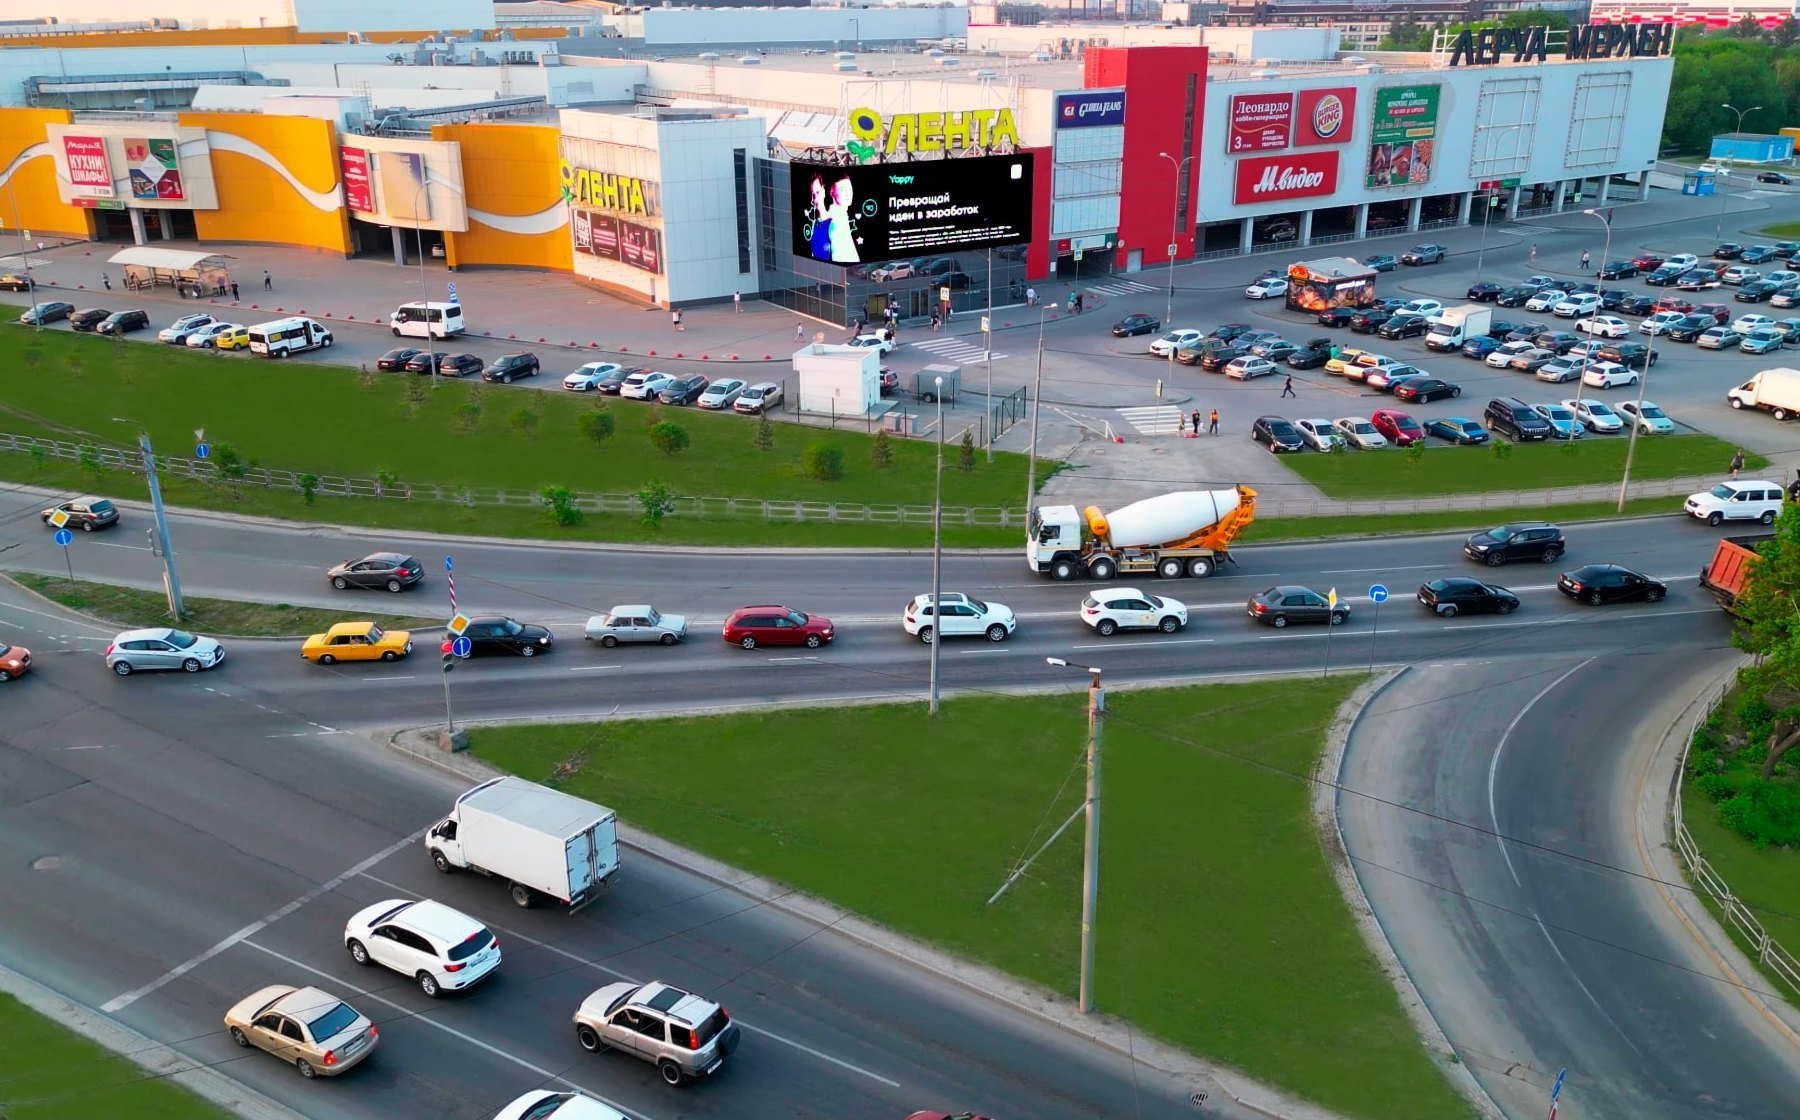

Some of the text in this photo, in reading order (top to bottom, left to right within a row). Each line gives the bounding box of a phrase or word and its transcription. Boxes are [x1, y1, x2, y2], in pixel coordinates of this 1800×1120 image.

[1450, 23, 1673, 66] ЛЕРУА МЕРЛЕН
[1236, 102, 1289, 114] Леонардо
[1318, 103, 1339, 118] BURGER
[1318, 110, 1339, 126] KING
[885, 107, 1019, 154] ЛЕНТА
[67, 141, 102, 153] Мария
[1234, 136, 1242, 149] 3
[69, 154, 106, 171] КУХНИ!
[72, 167, 109, 183] ШКАФЫ!
[889, 175, 914, 185] Yappy
[1253, 165, 1324, 193] М.видео
[576, 169, 648, 217] ЛЕНТА
[889, 192, 950, 209] Превращай
[889, 205, 979, 222] идеи в заработок
